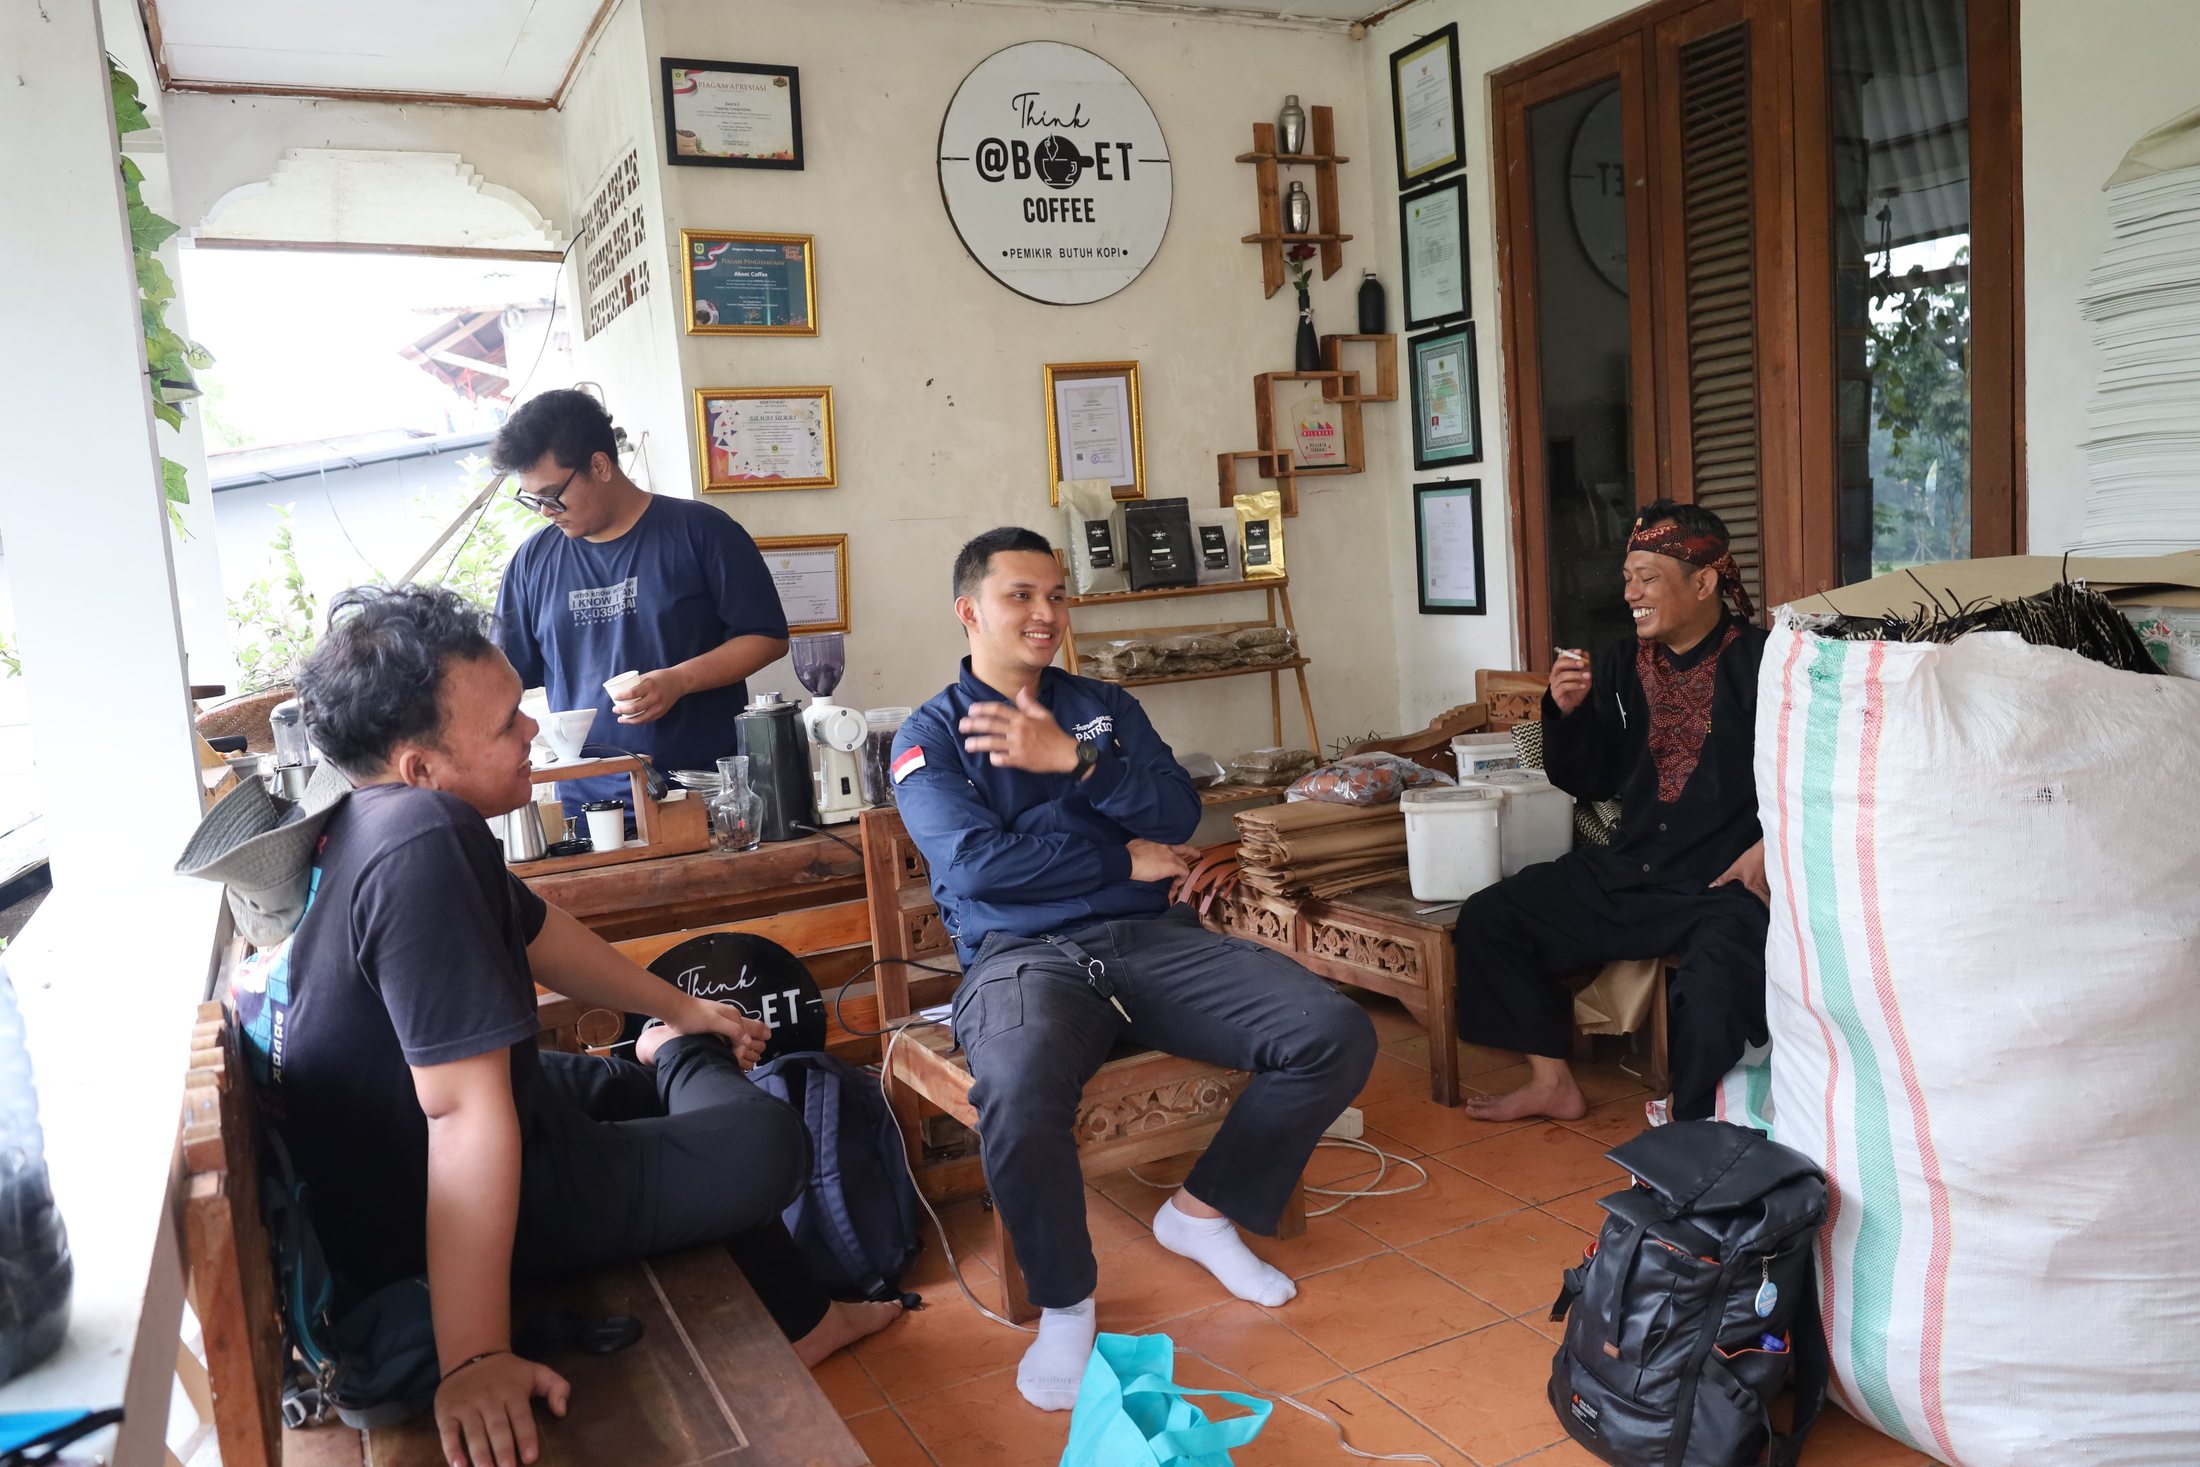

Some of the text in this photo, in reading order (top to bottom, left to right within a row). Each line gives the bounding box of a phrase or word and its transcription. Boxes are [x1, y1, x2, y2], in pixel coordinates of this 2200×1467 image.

[1011, 92, 1091, 129] Think
[1023, 197, 1096, 223] COFFEE
[1010, 247, 1121, 259] PEMIKIR BUTUH KOPI
[578, 596, 612, 608] KNOW
[1075, 722, 1113, 743] PATRIO
[677, 964, 757, 998] Think
